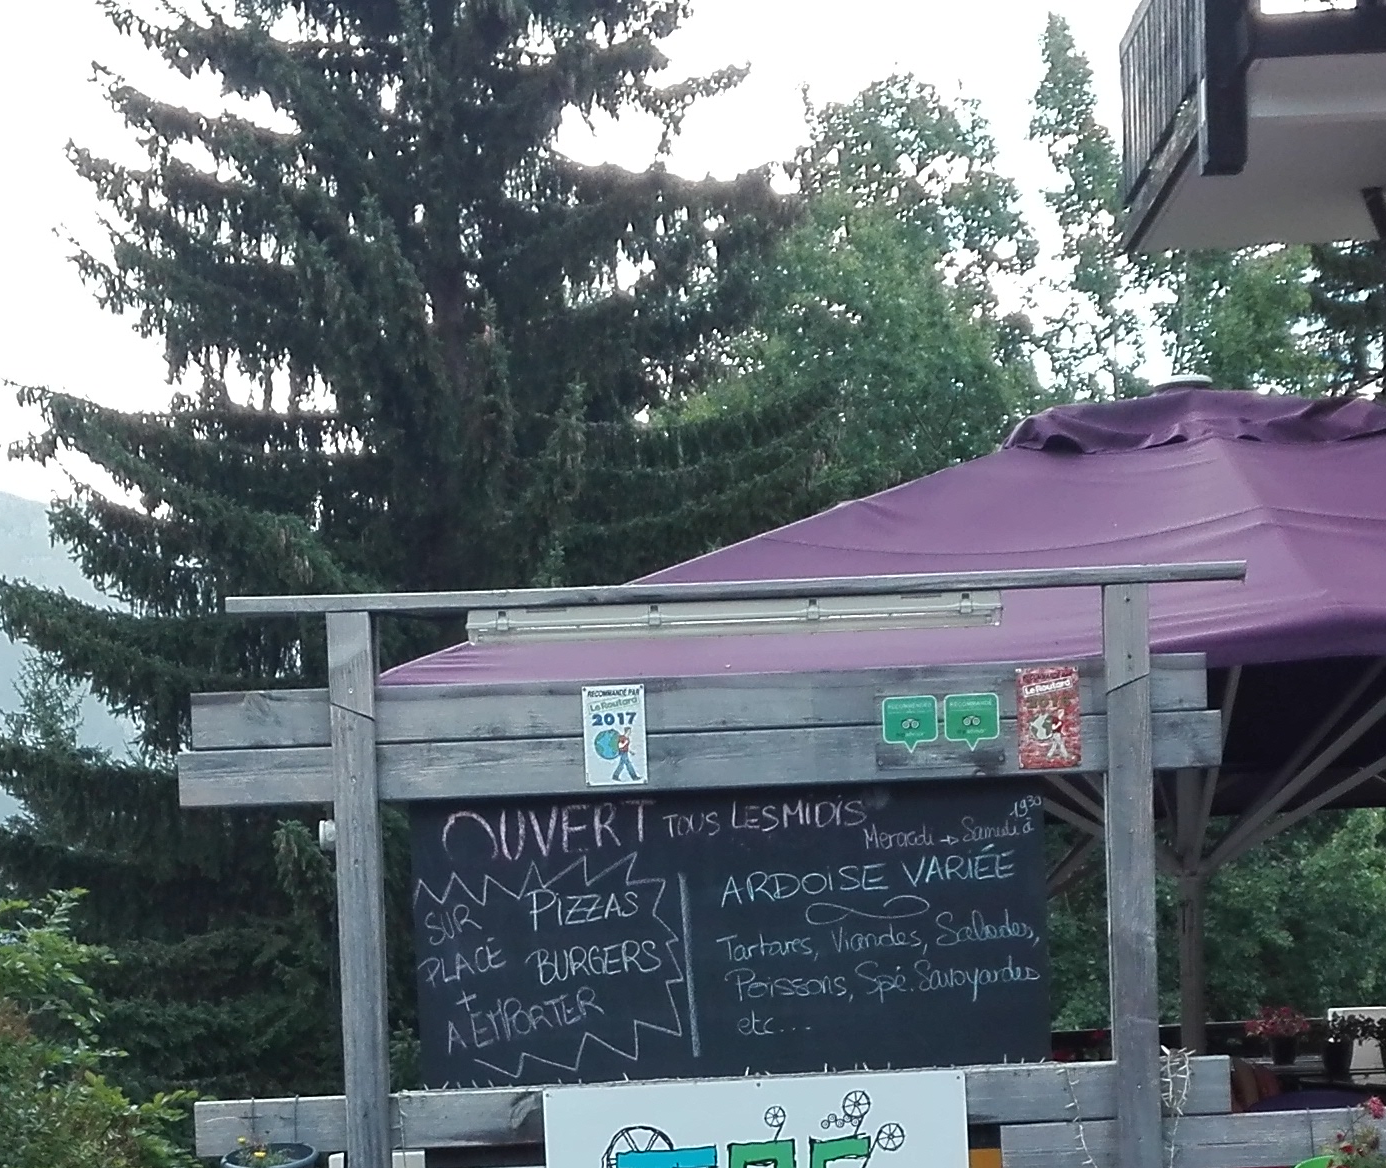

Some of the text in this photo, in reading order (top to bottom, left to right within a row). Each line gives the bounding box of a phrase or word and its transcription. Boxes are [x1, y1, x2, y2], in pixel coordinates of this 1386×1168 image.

[588, 687, 640, 698] RECOMMANDÉ PAR
[589, 697, 638, 713] Le Routard
[1036, 679, 1071, 692] Routard
[592, 711, 637, 727] 2017
[441, 795, 868, 861] OUVERT TOUS LES MIDIS
[721, 843, 1015, 908] ARDOISE VARIÉE
[424, 903, 483, 946] SUR
[524, 887, 638, 932] PIZZAS
[831, 923, 928, 955] Viandes,
[524, 940, 662, 986] BURGERS
[724, 967, 854, 1003] Poissons,
[914, 954, 1041, 1002] Savoyardes
[470, 986, 605, 1048] EMPORTER
